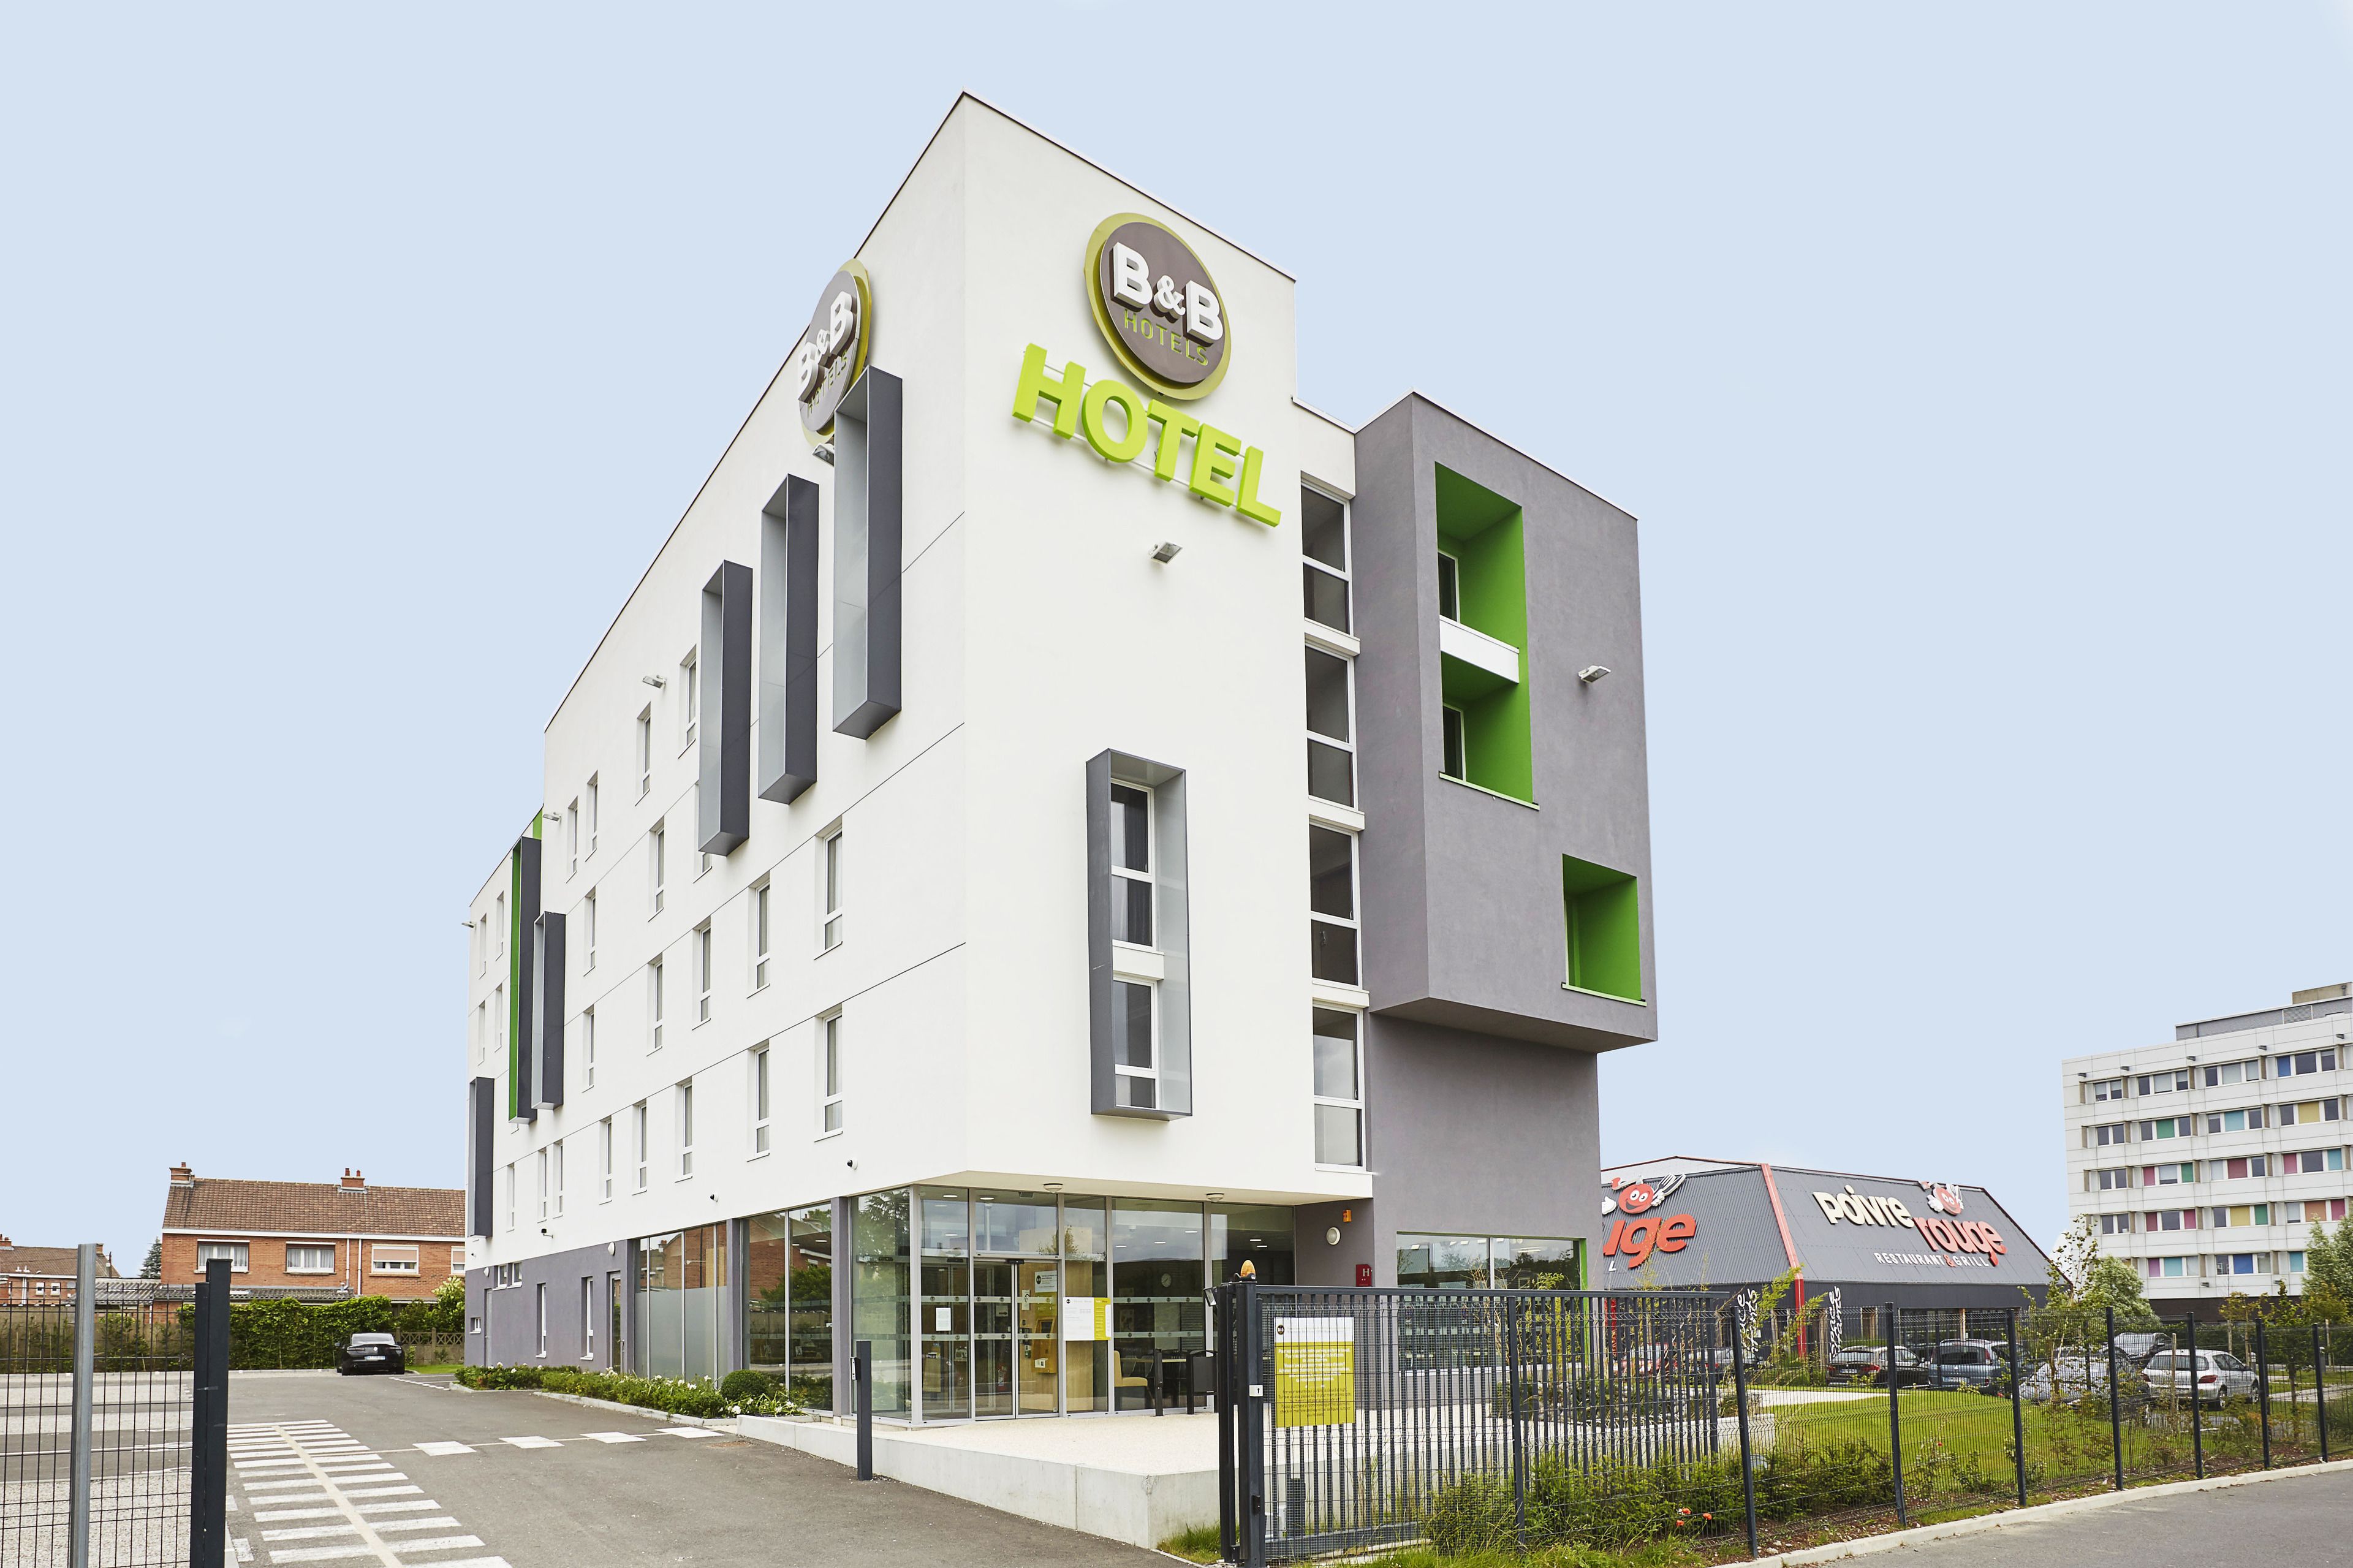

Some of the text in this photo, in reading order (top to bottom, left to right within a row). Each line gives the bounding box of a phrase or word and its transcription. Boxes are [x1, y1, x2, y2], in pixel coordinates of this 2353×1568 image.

[1111, 241, 1224, 344] B&B
[798, 290, 855, 403] B&B
[1123, 308, 1210, 368] HOTELS
[1012, 342, 1282, 528] HOTEL
[1813, 1184, 1915, 1228] poivre
[1912, 1217, 2007, 1267] rouge
